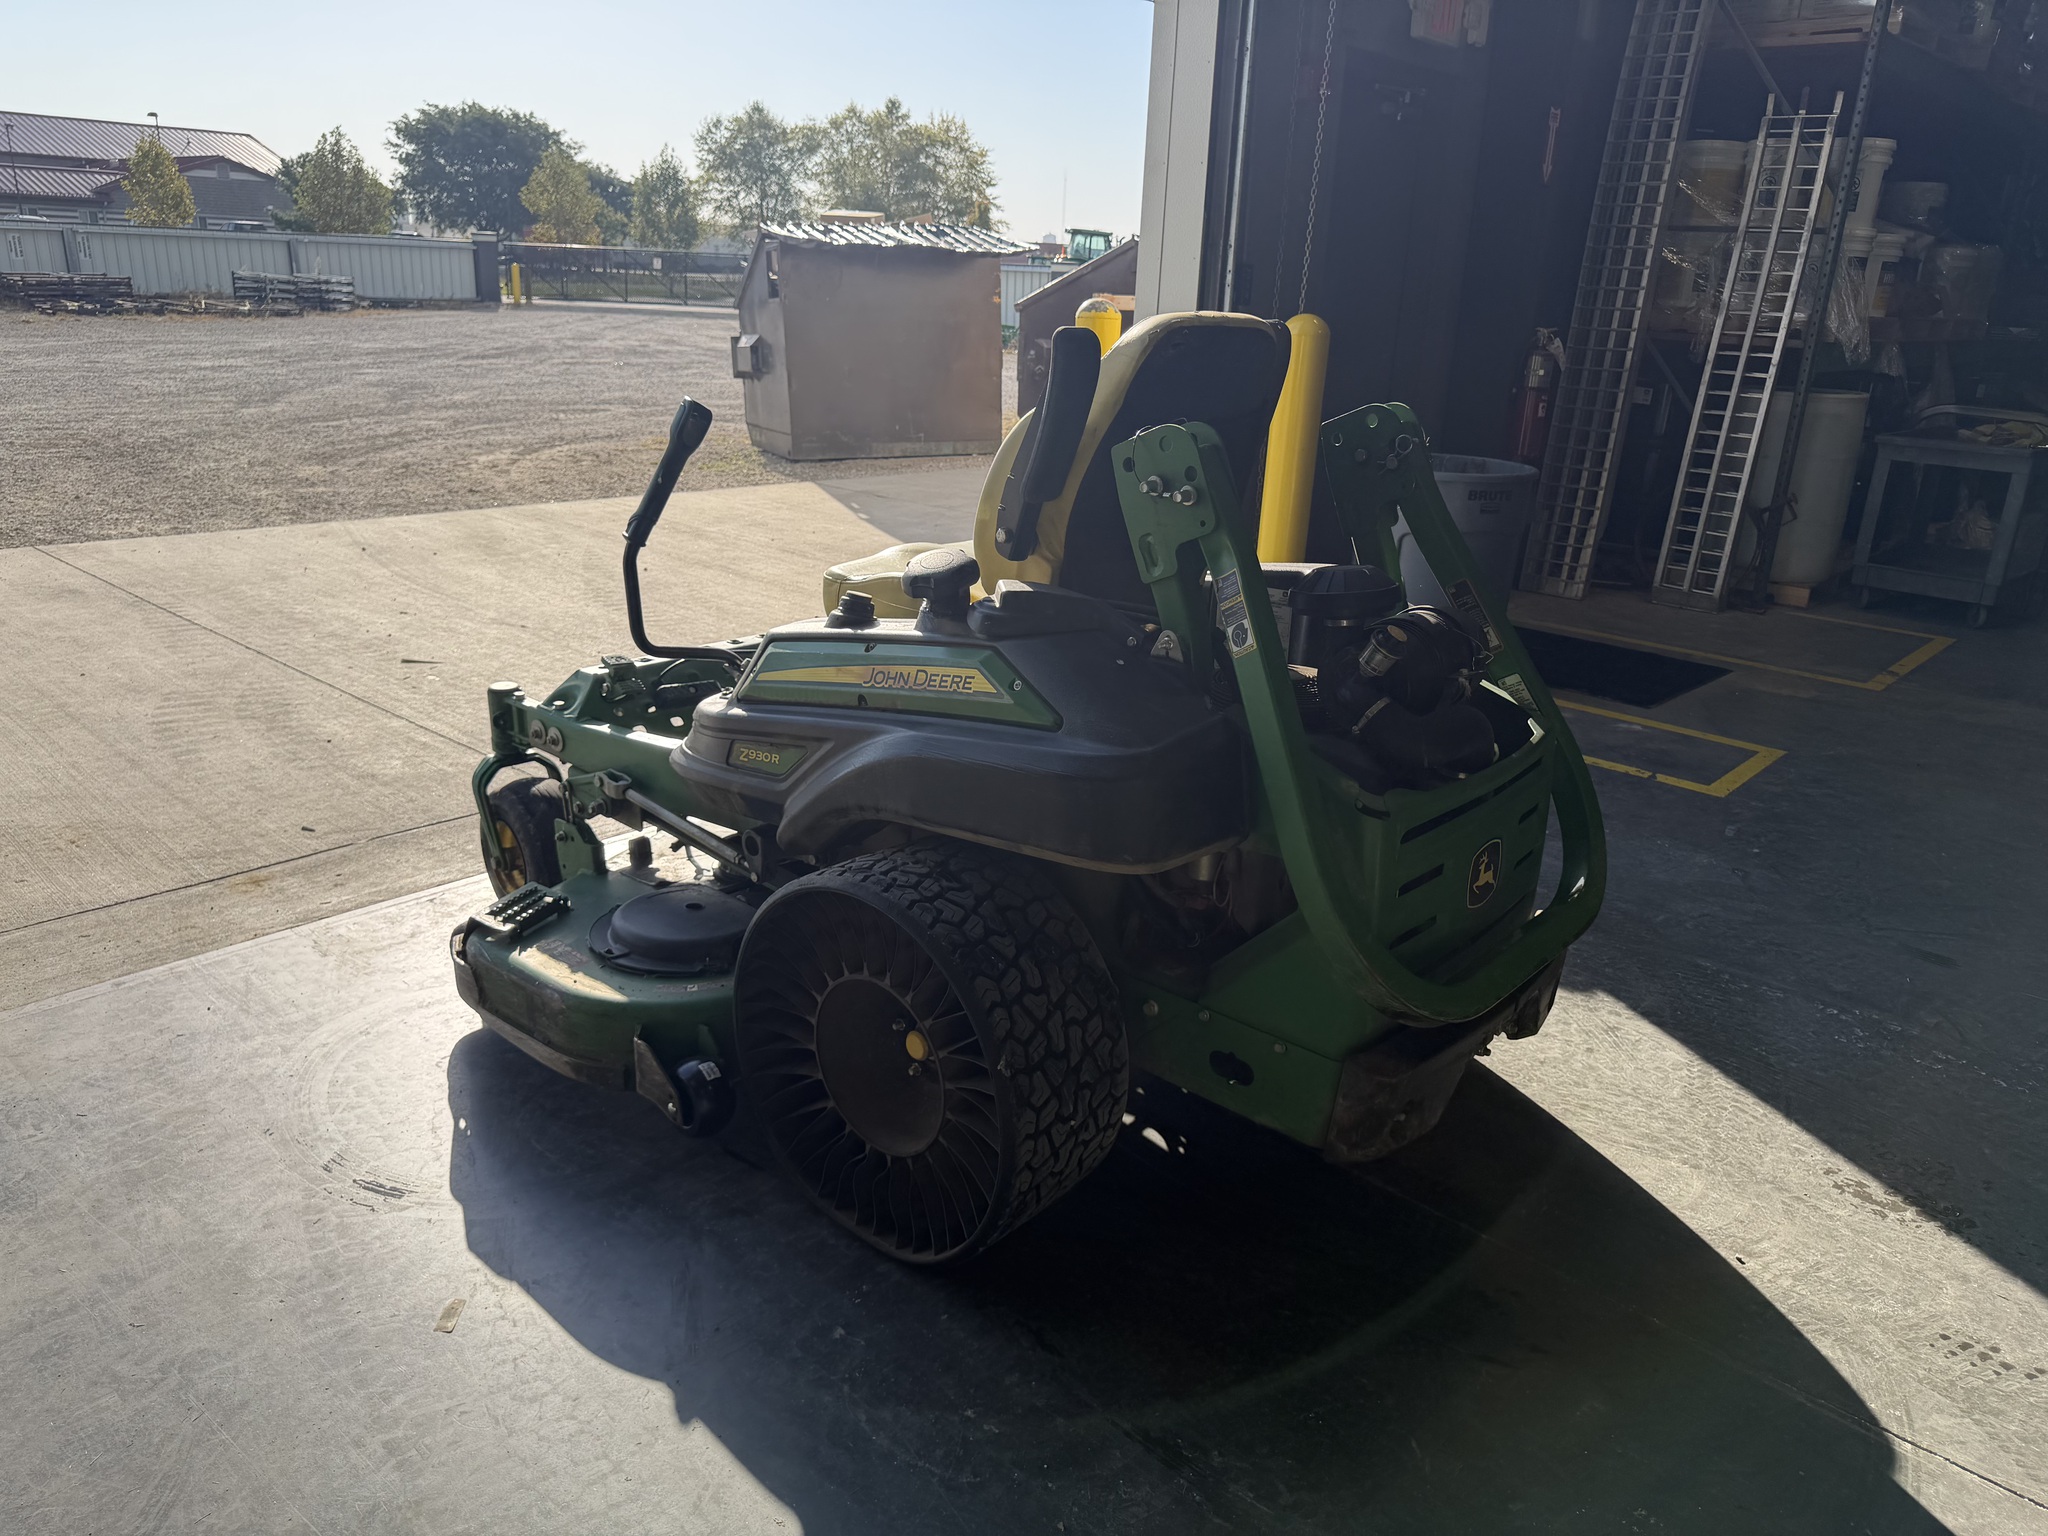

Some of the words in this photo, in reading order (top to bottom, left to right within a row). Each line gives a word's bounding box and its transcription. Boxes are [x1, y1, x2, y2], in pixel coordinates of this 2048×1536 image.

[1468, 490, 1512, 501] BRUTE
[862, 667, 911, 687] JOHN
[913, 669, 976, 691] DEERE
[740, 748, 780, 764] Z930R
